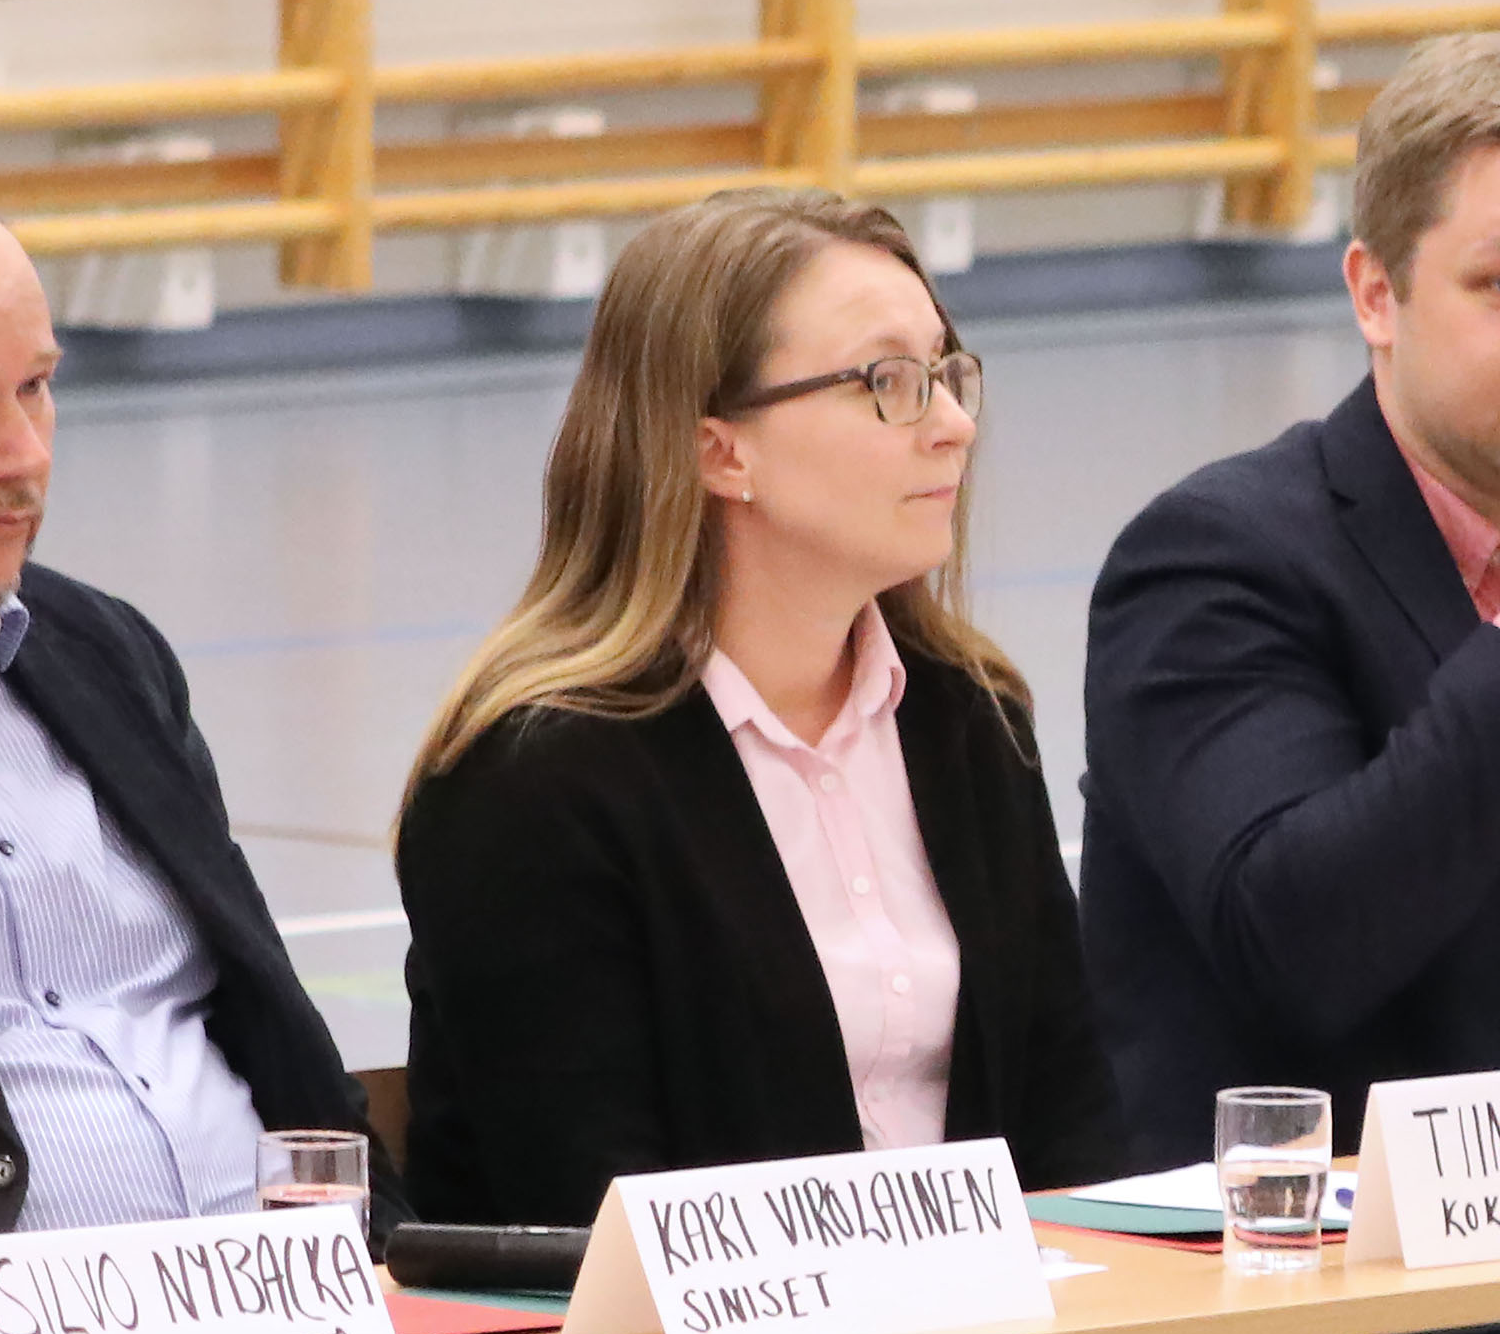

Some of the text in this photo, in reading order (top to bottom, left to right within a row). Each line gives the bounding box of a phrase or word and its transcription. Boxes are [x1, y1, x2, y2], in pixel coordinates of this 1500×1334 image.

[649, 1167, 1003, 1275] KARI VIROLAINEN
[152, 1233, 375, 1325] NYBACKA
[683, 1271, 831, 1333] SINISET
